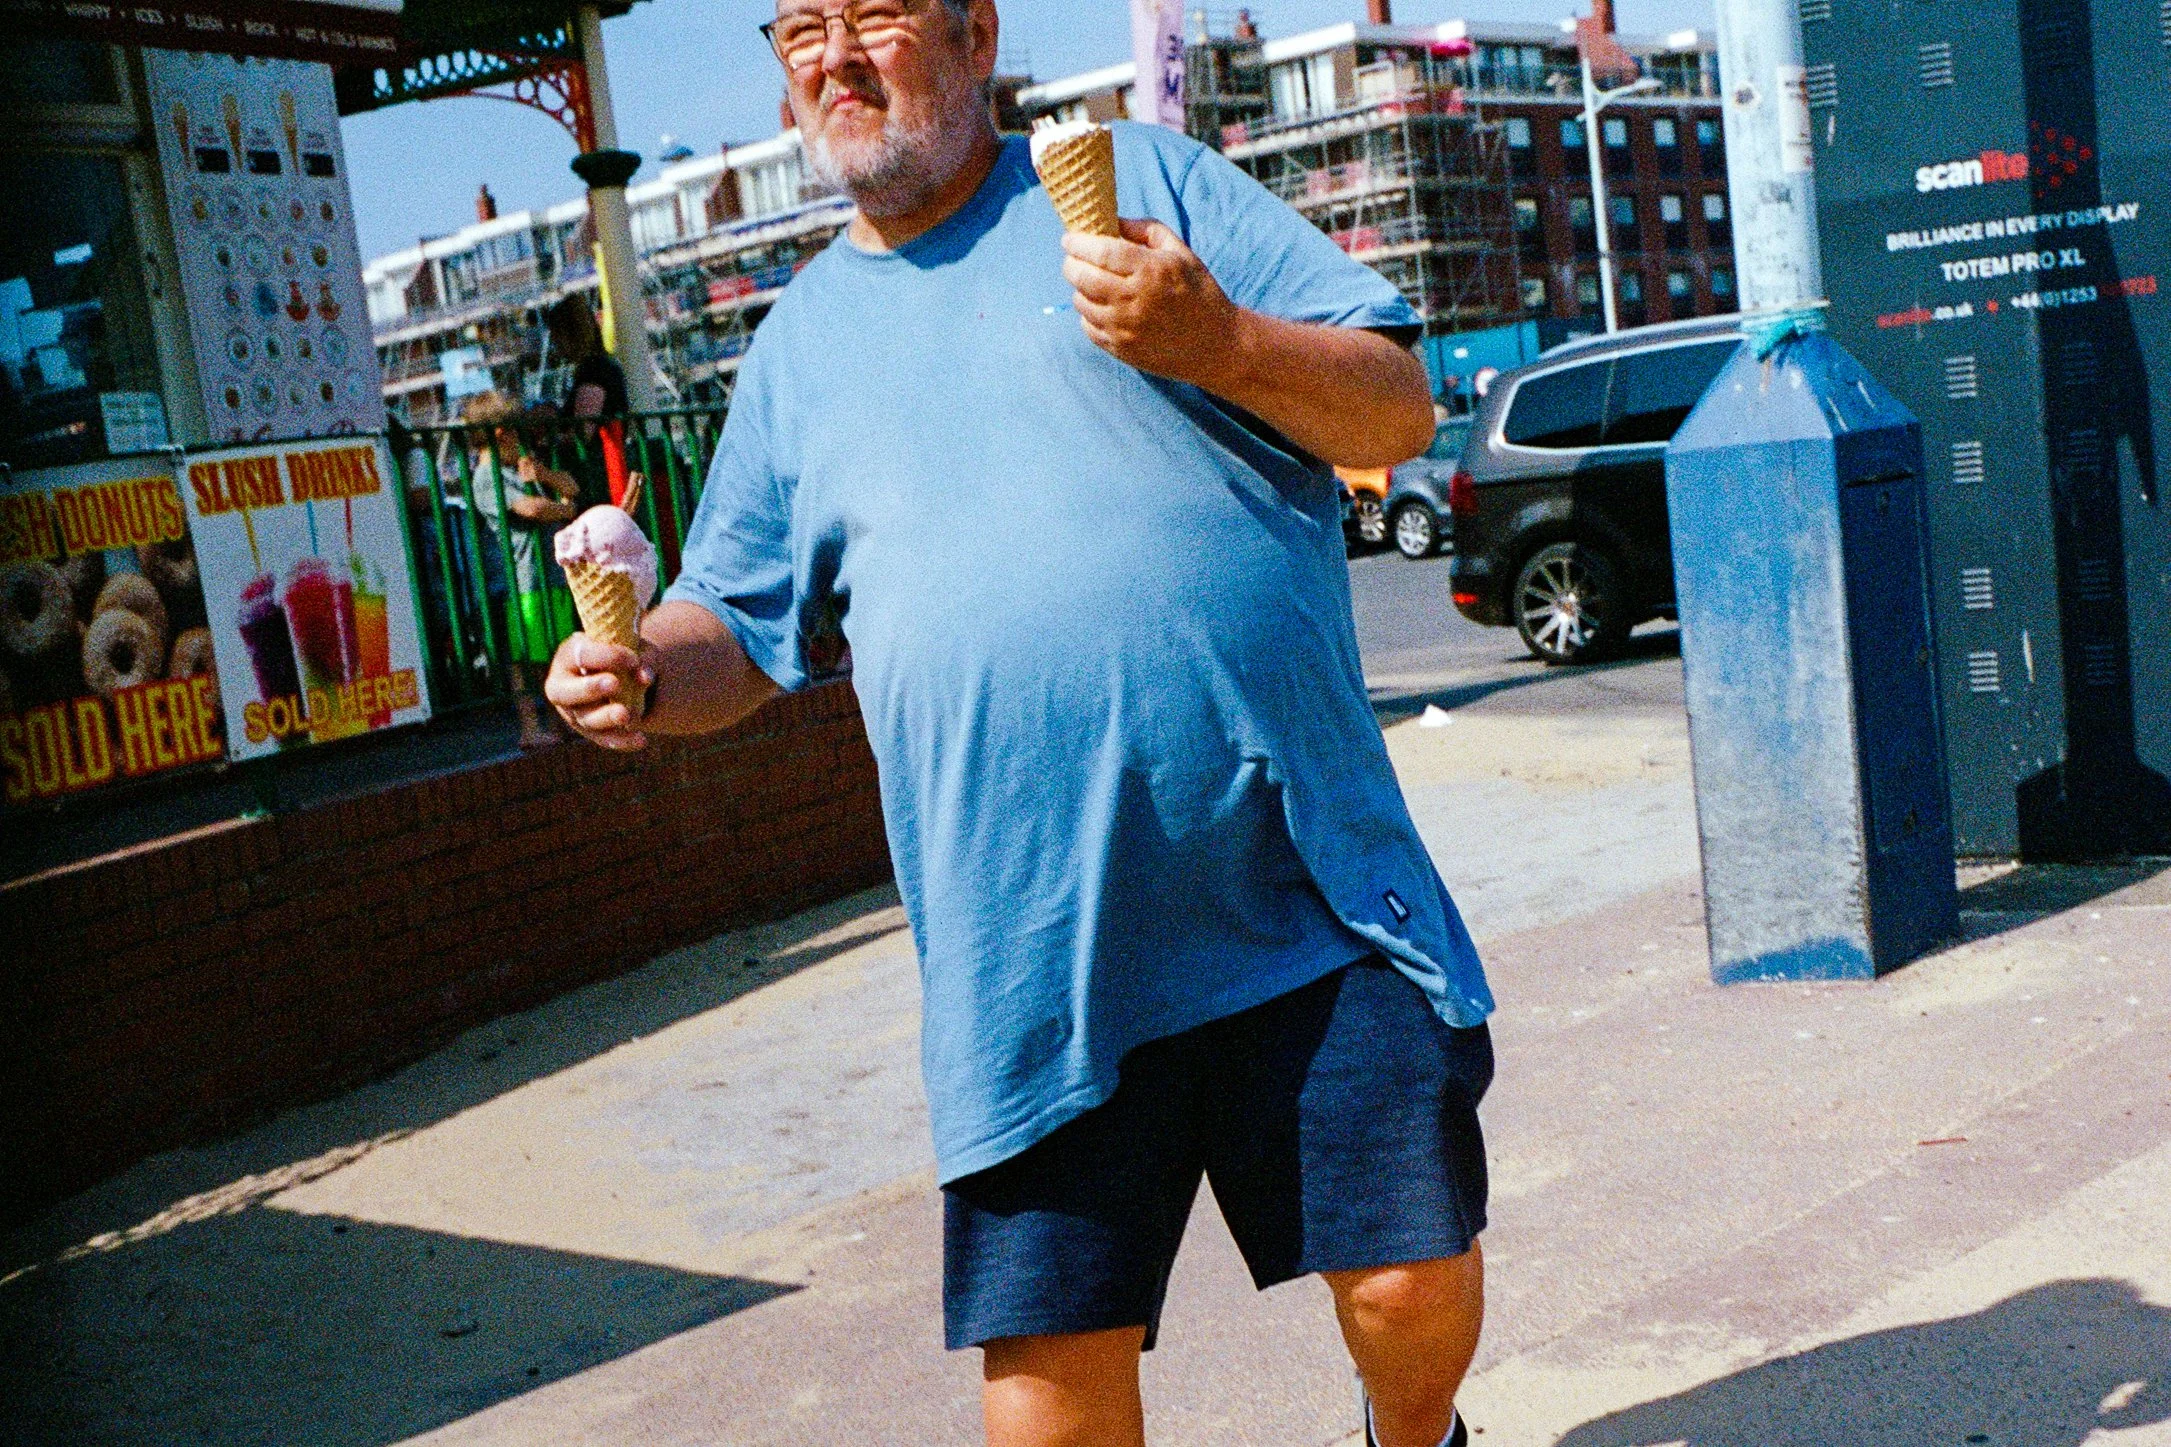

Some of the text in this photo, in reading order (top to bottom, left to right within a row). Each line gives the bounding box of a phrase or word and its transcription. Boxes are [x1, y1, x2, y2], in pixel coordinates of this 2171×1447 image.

[1887, 202, 2139, 251] BRILLIANCE IN EVERY DISPLAY
[1941, 248, 2085, 281] TOTEM PRO XL
[53, 475, 183, 551] DONUTS
[188, 445, 381, 517] SLUSH DRINKS
[1, 672, 223, 799] SOLD HERE
[244, 669, 419, 744] SOLD HERE
